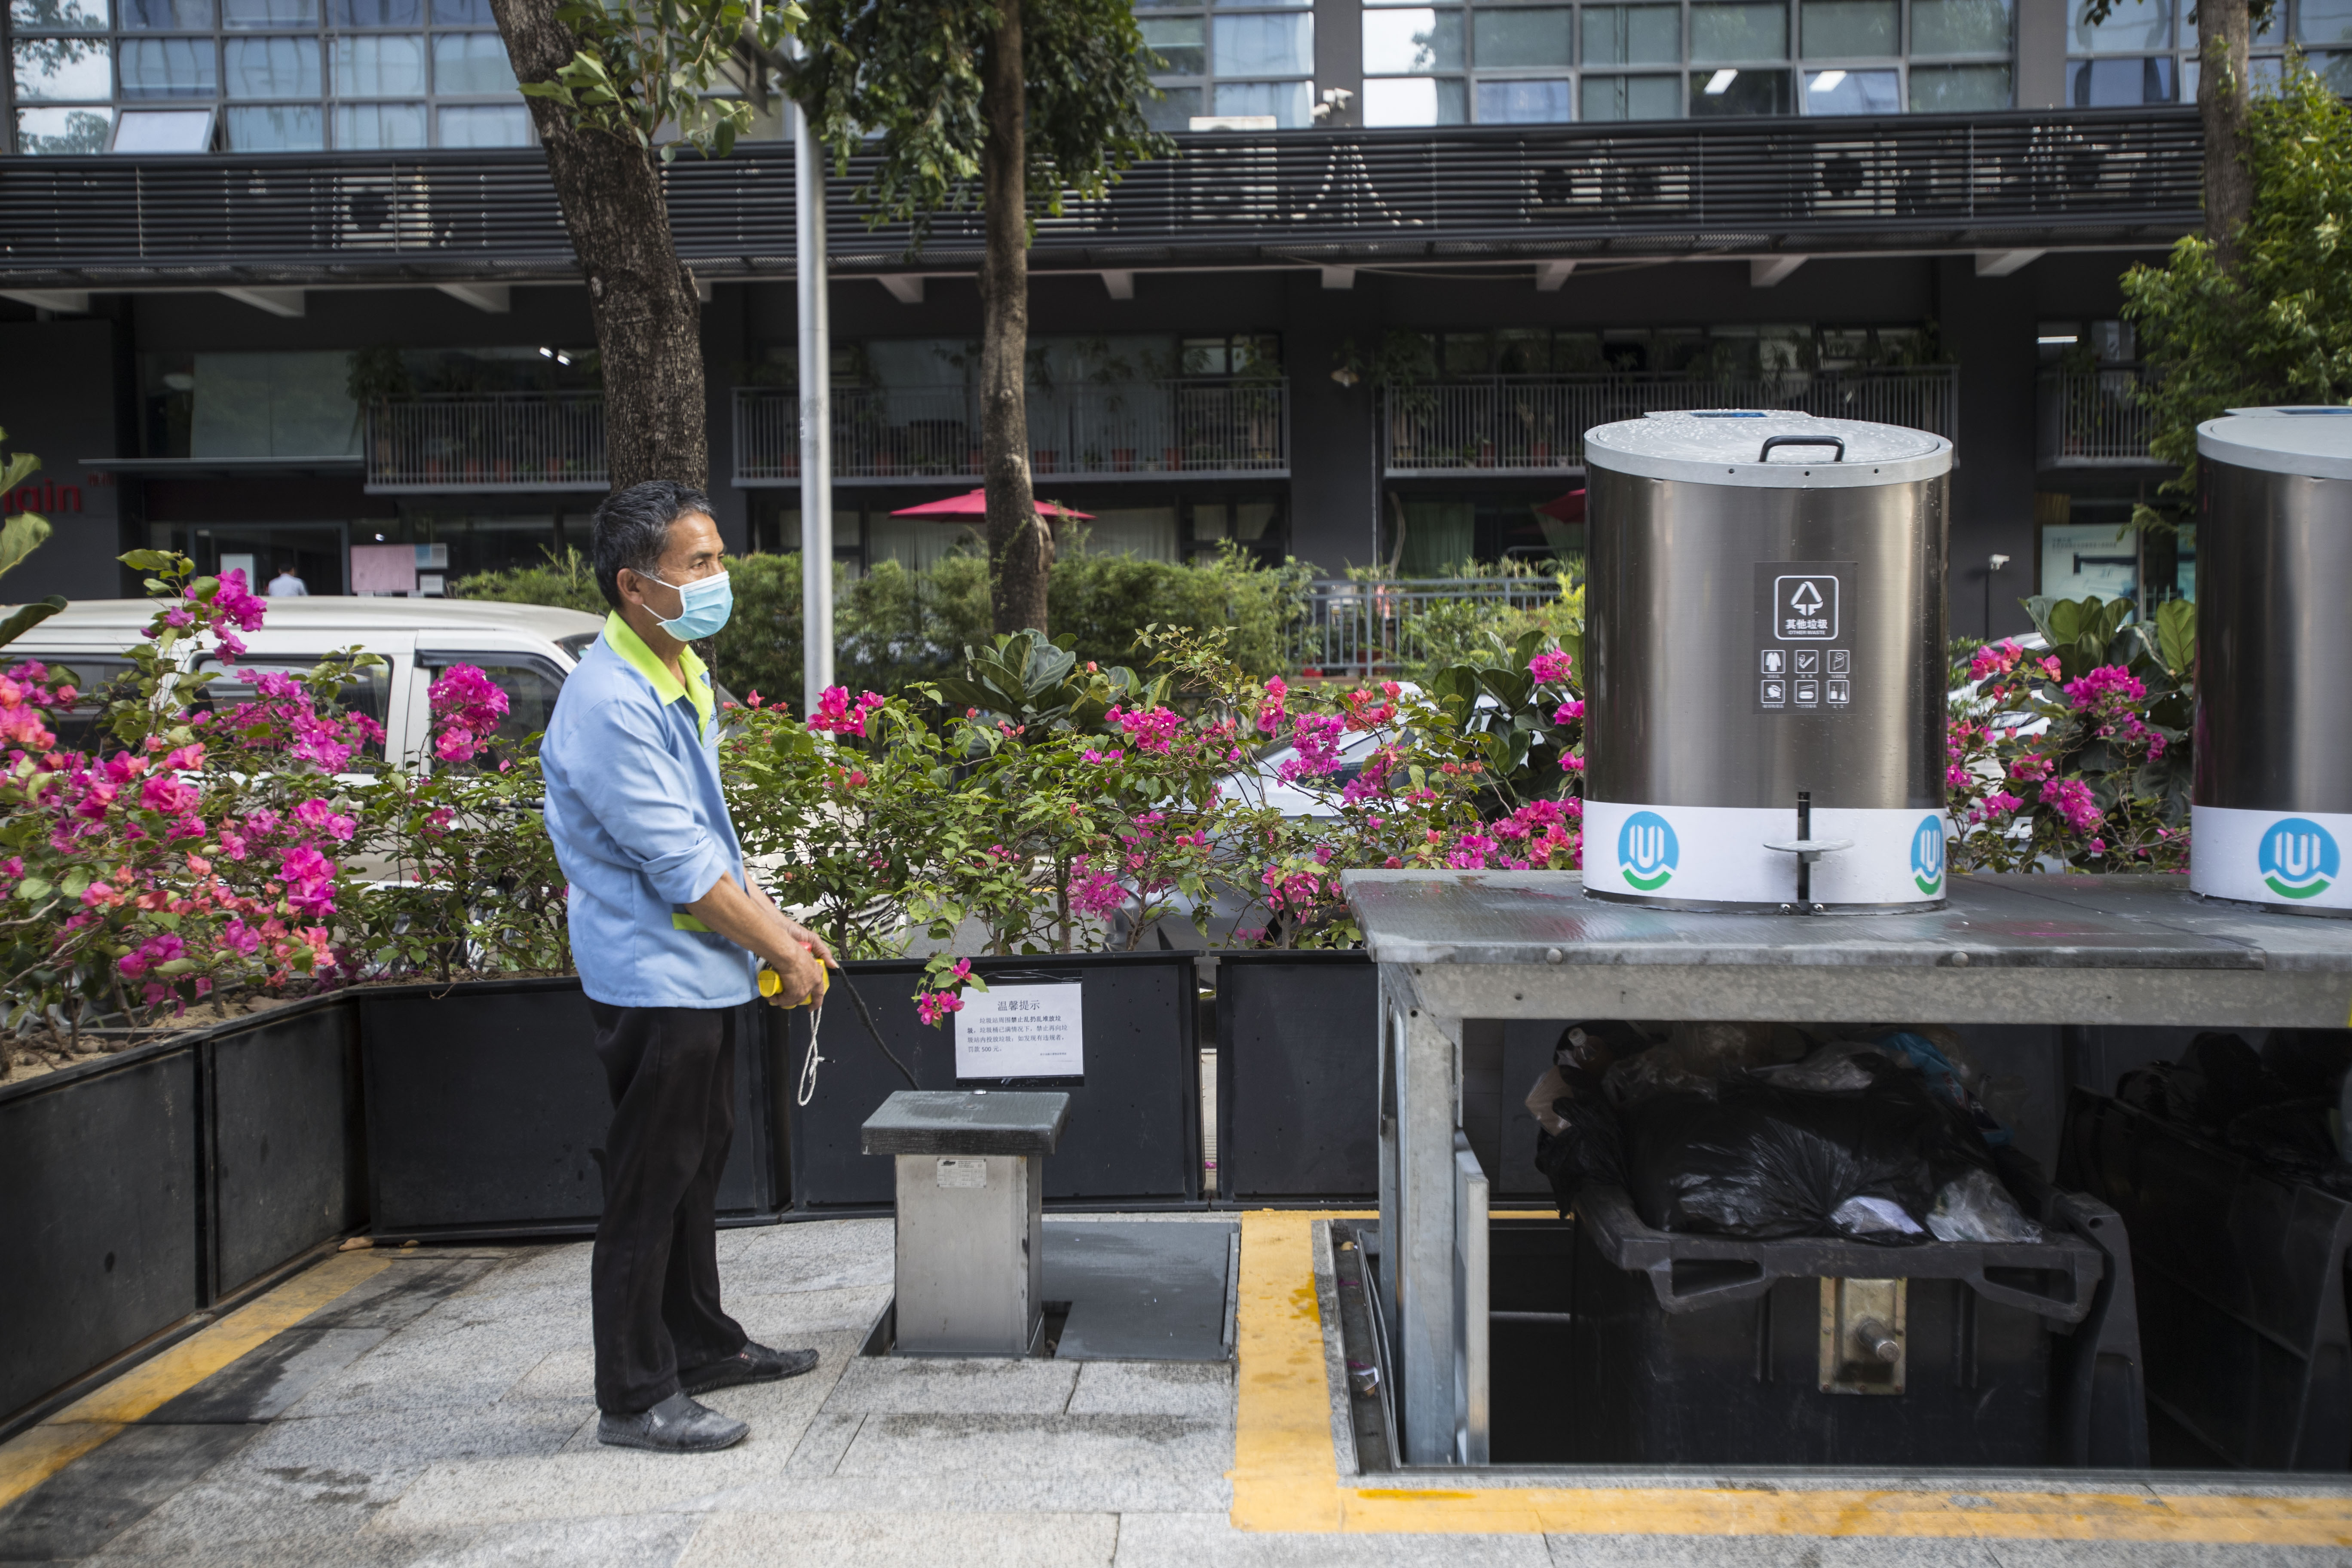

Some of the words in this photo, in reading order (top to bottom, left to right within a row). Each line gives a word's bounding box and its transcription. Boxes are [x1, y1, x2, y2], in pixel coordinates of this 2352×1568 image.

[1785, 619, 1828, 630] 其他垃圾
[998, 1000, 1040, 1011] 温馨提示
[980, 1015, 1061, 1023] 垃圾站周围禁止乱扔乱堆放垃
